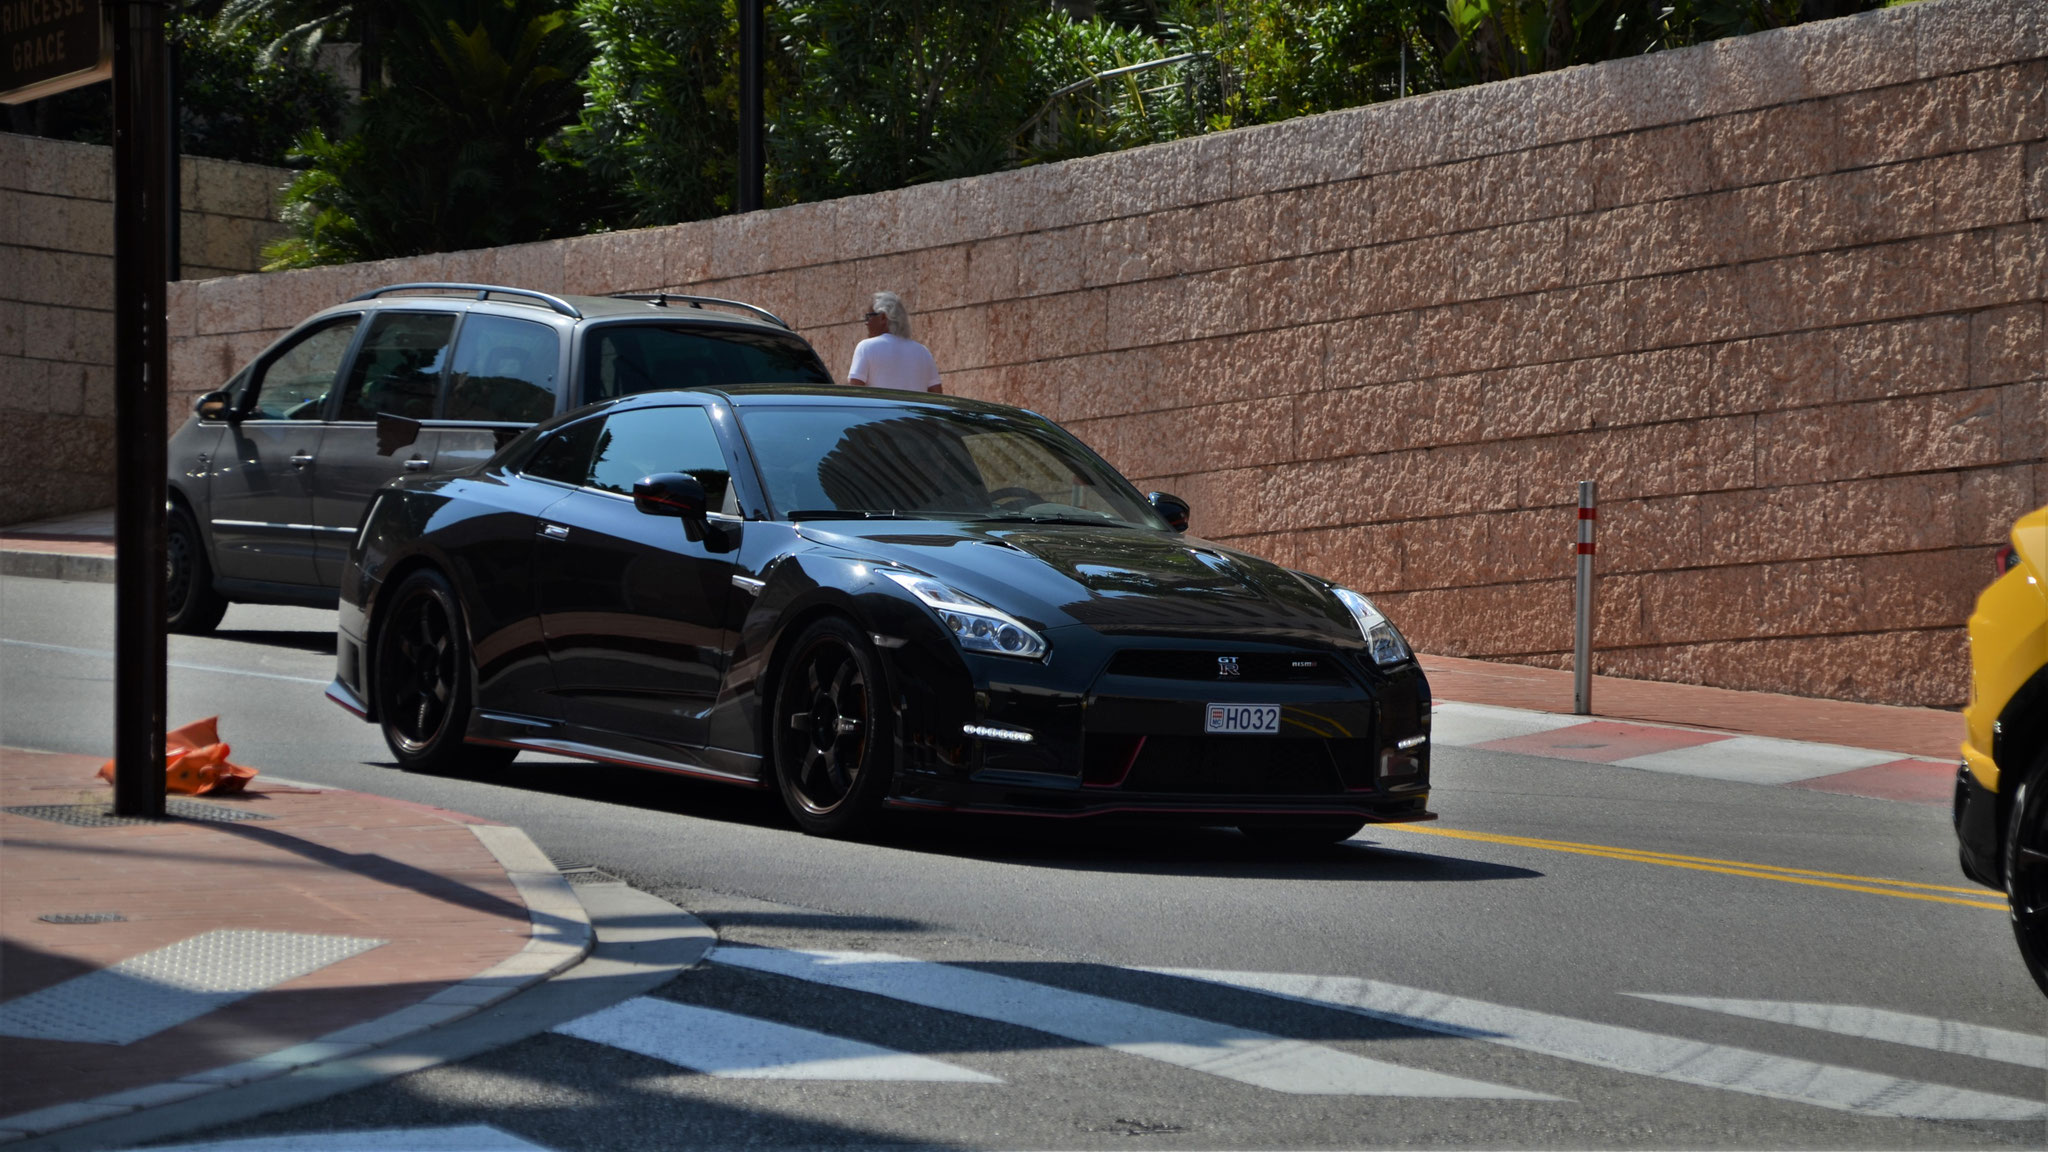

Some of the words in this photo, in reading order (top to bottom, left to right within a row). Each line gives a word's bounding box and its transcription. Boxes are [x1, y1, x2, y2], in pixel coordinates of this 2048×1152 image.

[0, 0, 84, 34] RINCESS
[12, 29, 65, 72] GRACE
[1219, 663, 1240, 675] R
[1226, 708, 1277, 730] H032
